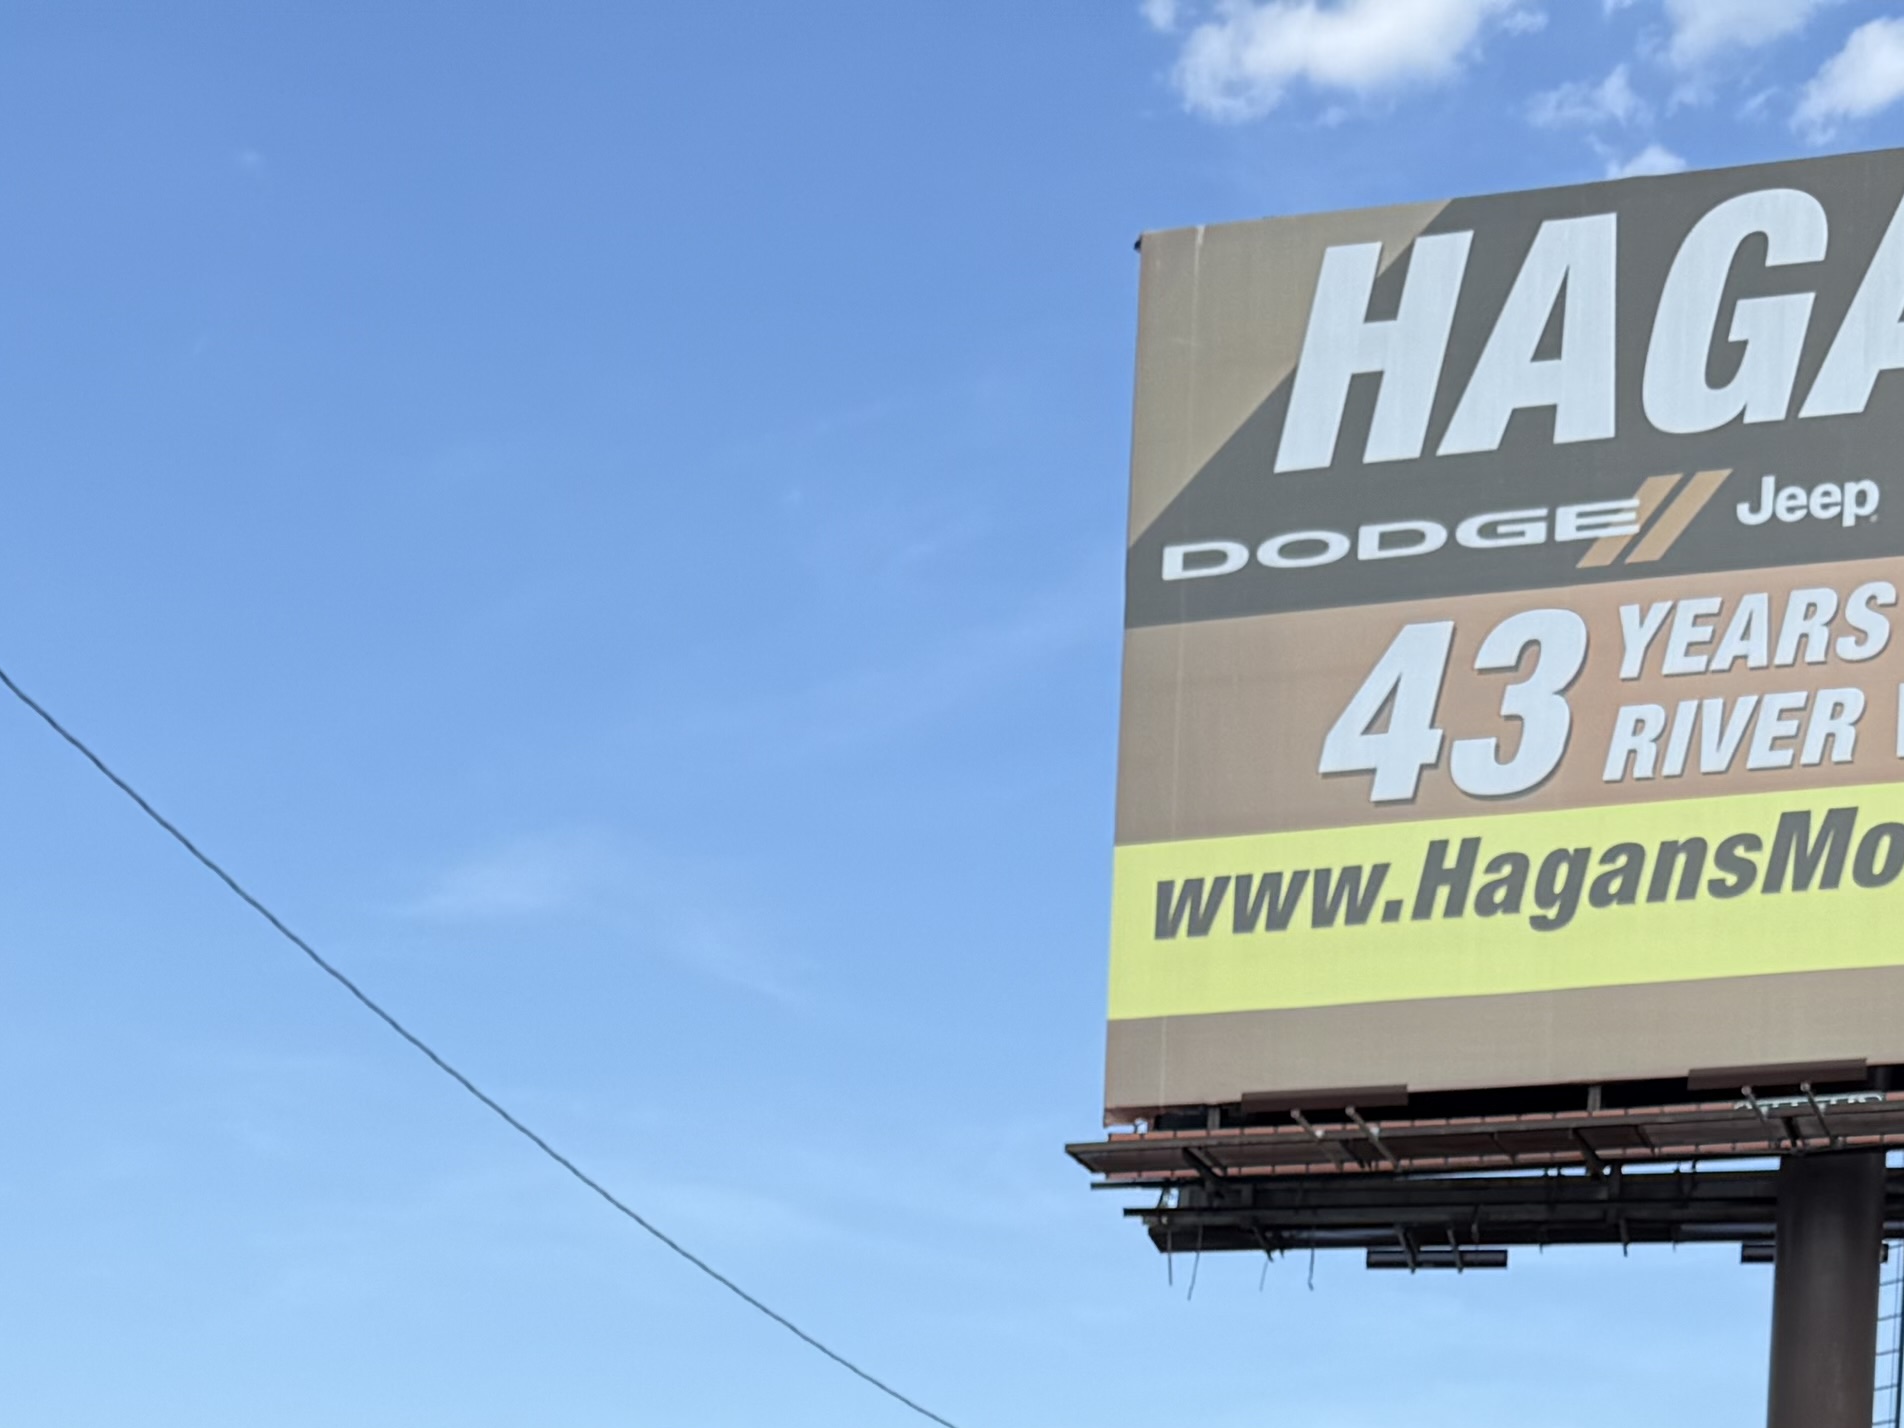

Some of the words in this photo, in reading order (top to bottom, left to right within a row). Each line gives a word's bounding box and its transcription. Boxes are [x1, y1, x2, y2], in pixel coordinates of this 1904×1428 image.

[1162, 498, 1641, 581] DODGE
[1736, 475, 1880, 527] Jeep
[1618, 578, 1897, 681] YEARS
[1318, 607, 1590, 803] 43
[1602, 687, 1866, 783] RIVER
